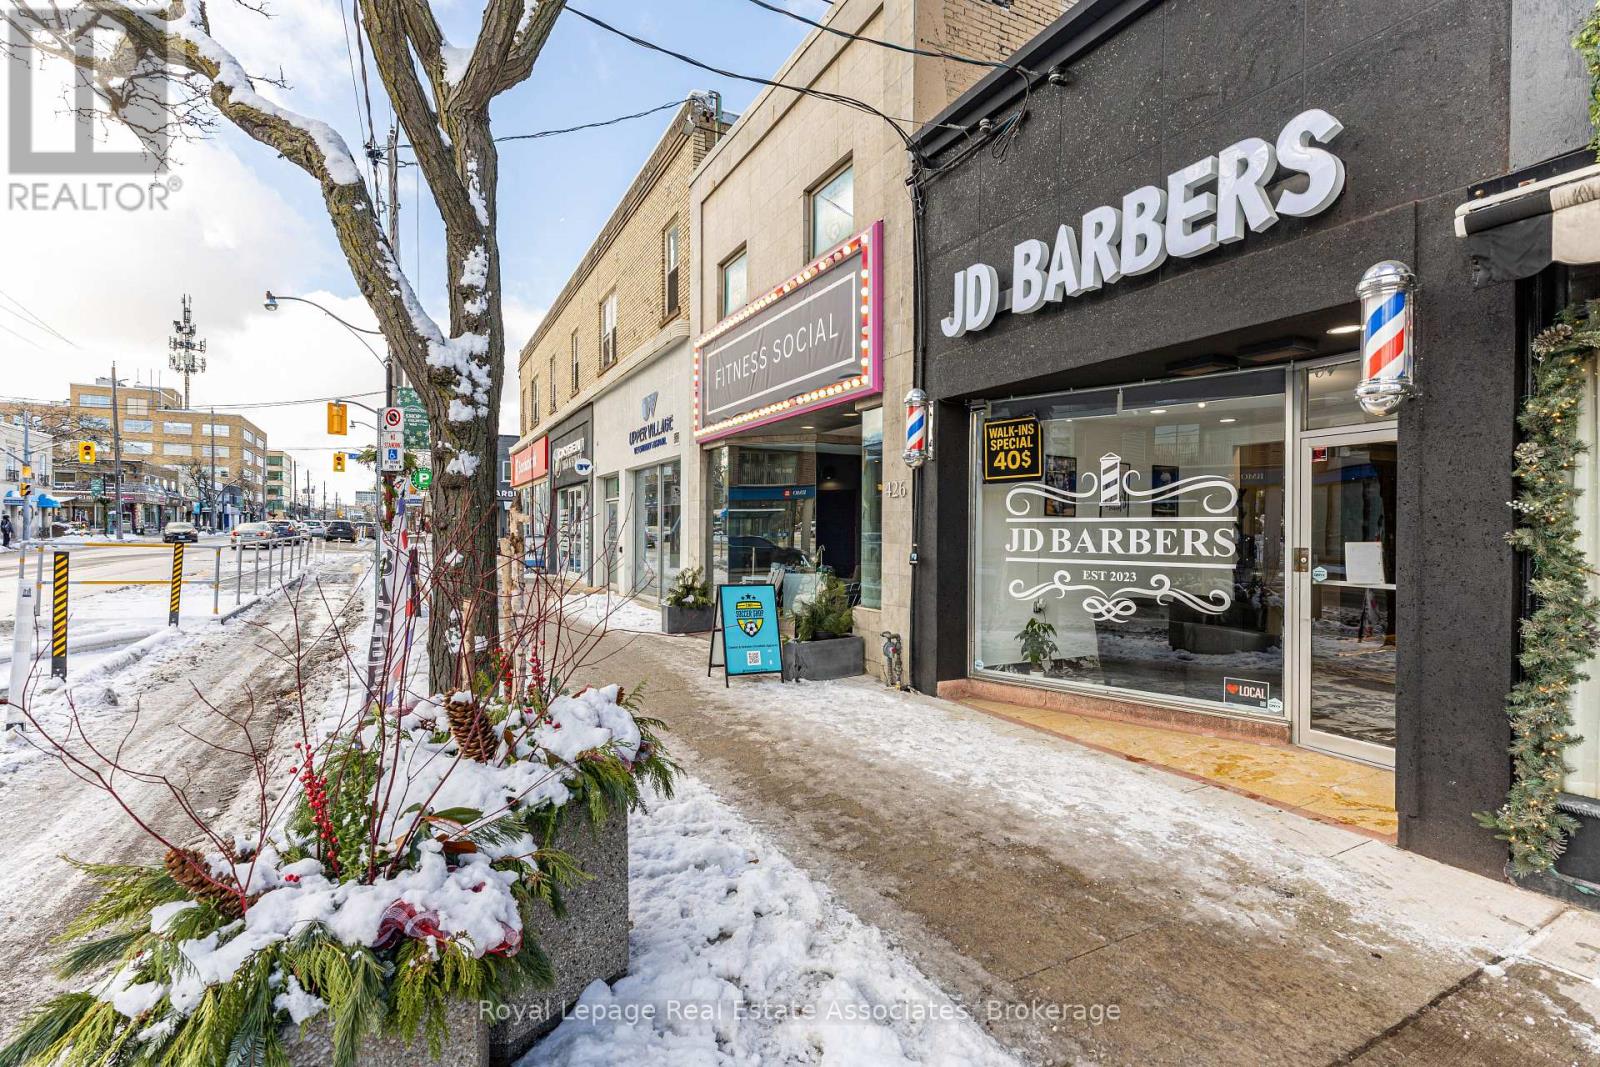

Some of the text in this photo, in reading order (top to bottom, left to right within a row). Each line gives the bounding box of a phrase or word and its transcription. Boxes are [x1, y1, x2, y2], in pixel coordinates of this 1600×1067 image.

[940, 107, 1346, 338] JD BARBERS
[715, 312, 838, 390] FITNESS SOCIAL
[629, 426, 648, 446] UPPER
[647, 414, 674, 439] VILLAGE
[989, 423, 1035, 440] WALK-INS
[990, 436, 1034, 451] SPECIAL
[993, 449, 1032, 470] 40$
[419, 473, 430, 483] P
[885, 481, 907, 498] 426
[1005, 528, 1237, 558] JD BARBERS
[1082, 570, 1137, 582] EST 2023
[736, 609, 764, 618] SOCCER SHOP
[1239, 685, 1267, 699] LOCAL
